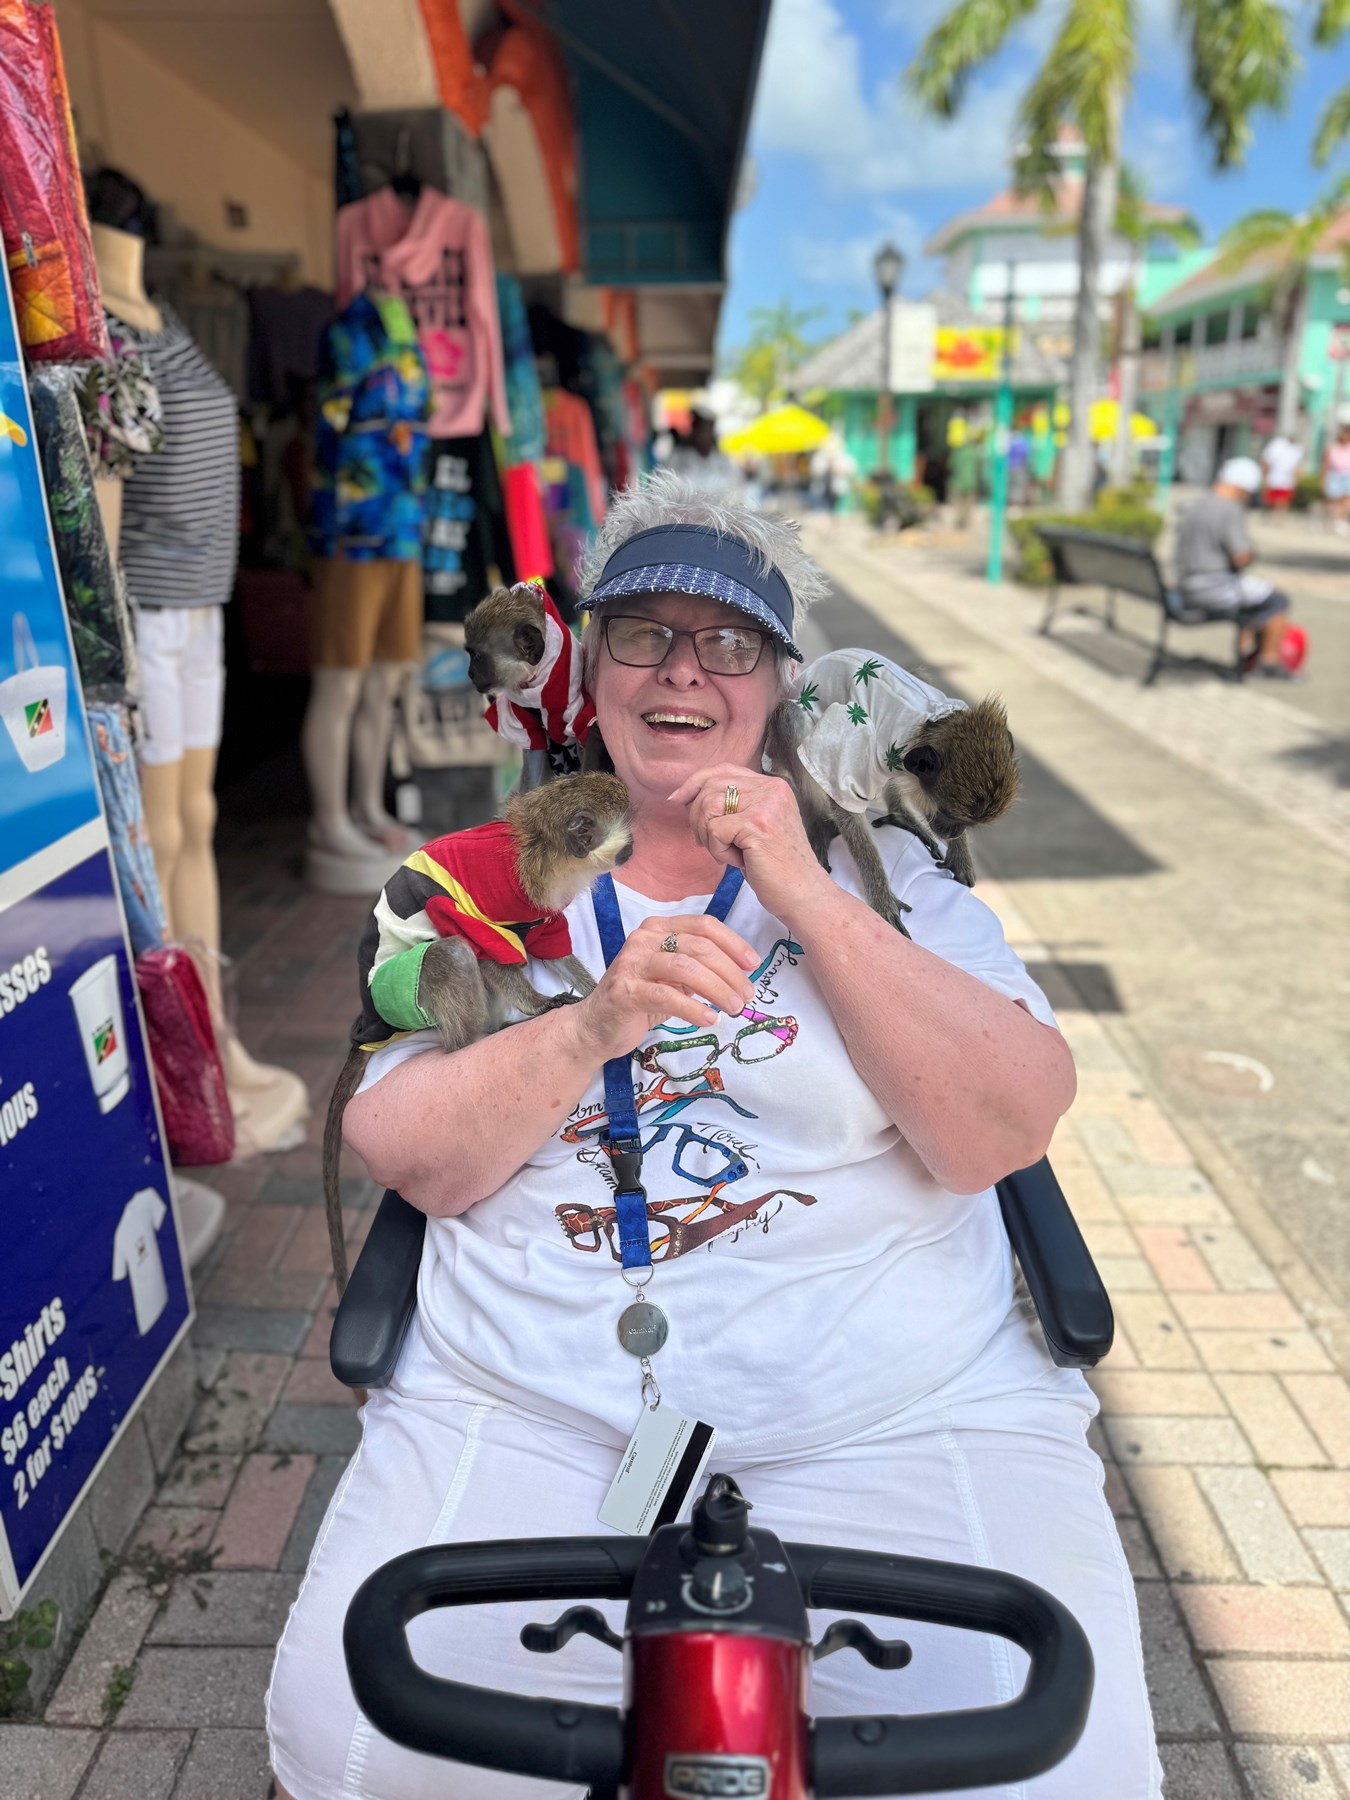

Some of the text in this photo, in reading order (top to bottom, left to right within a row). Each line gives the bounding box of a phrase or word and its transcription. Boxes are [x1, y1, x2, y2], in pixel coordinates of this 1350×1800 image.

[0, 945, 51, 1019] sses
[1, 1356, 70, 1465] $6 each
[13, 1469, 29, 1510] 2
[26, 1434, 51, 1490] for
[624, 1451, 637, 1474] Carnival
[672, 1765, 763, 1795] PRIDE
